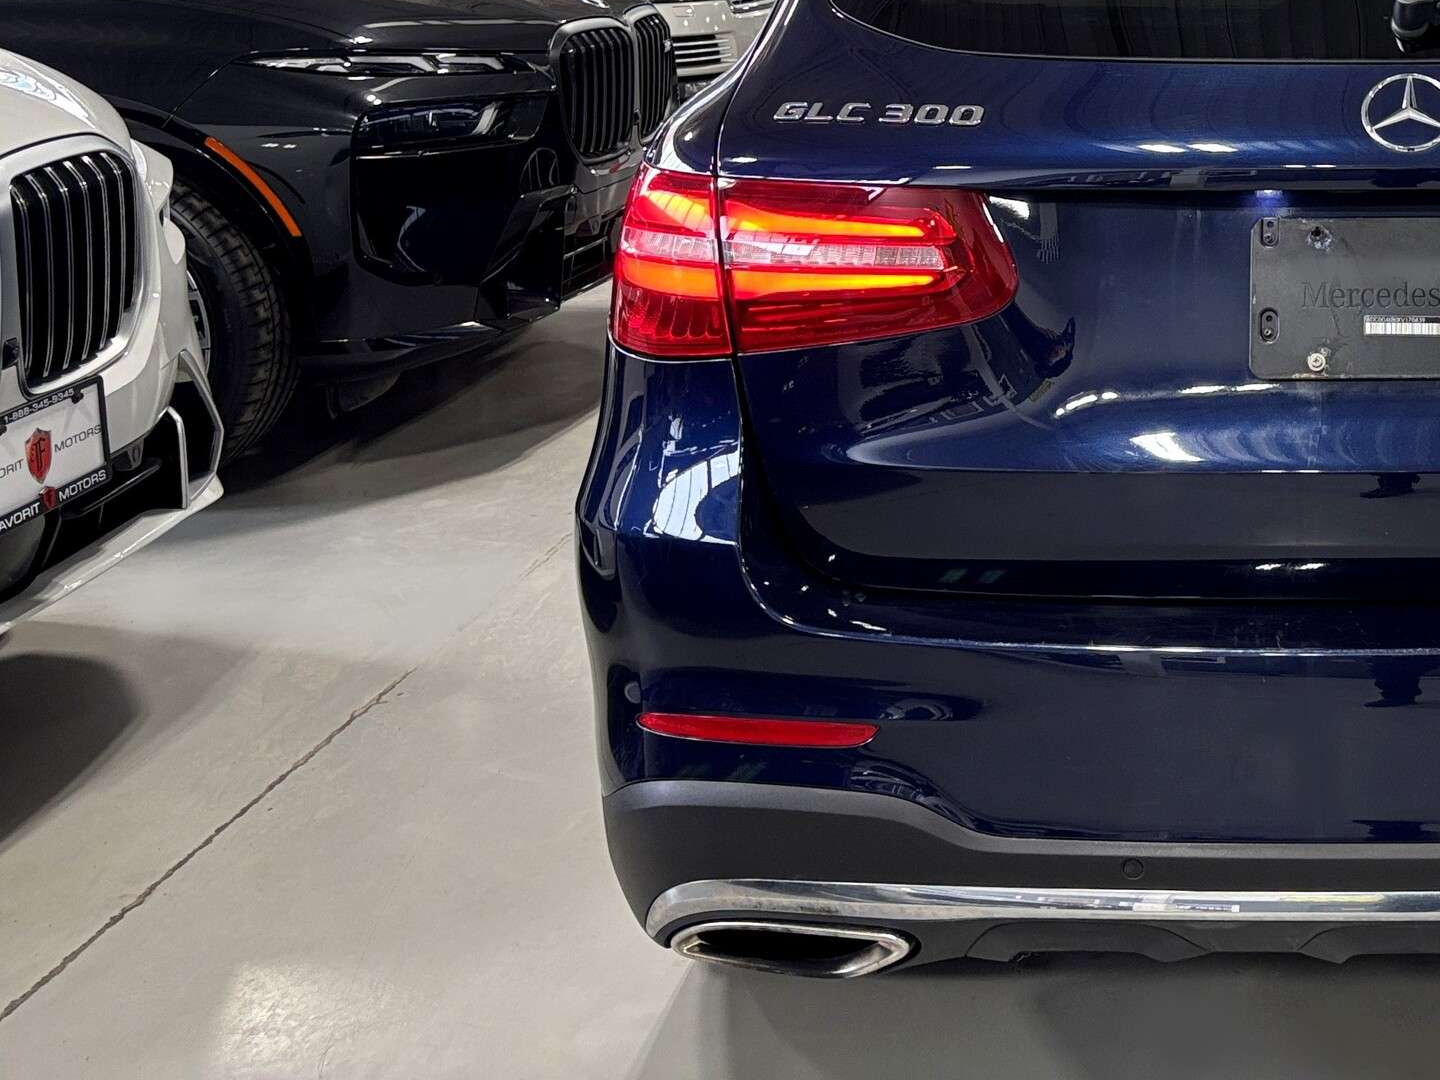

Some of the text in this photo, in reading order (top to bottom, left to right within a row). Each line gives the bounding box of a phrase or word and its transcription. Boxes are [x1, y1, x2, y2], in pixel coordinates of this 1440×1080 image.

[773, 101, 985, 126] GLC 300
[0, 424, 102, 479] ORIT MOTORS
[0, 469, 107, 532] AVORIT MOTORS
